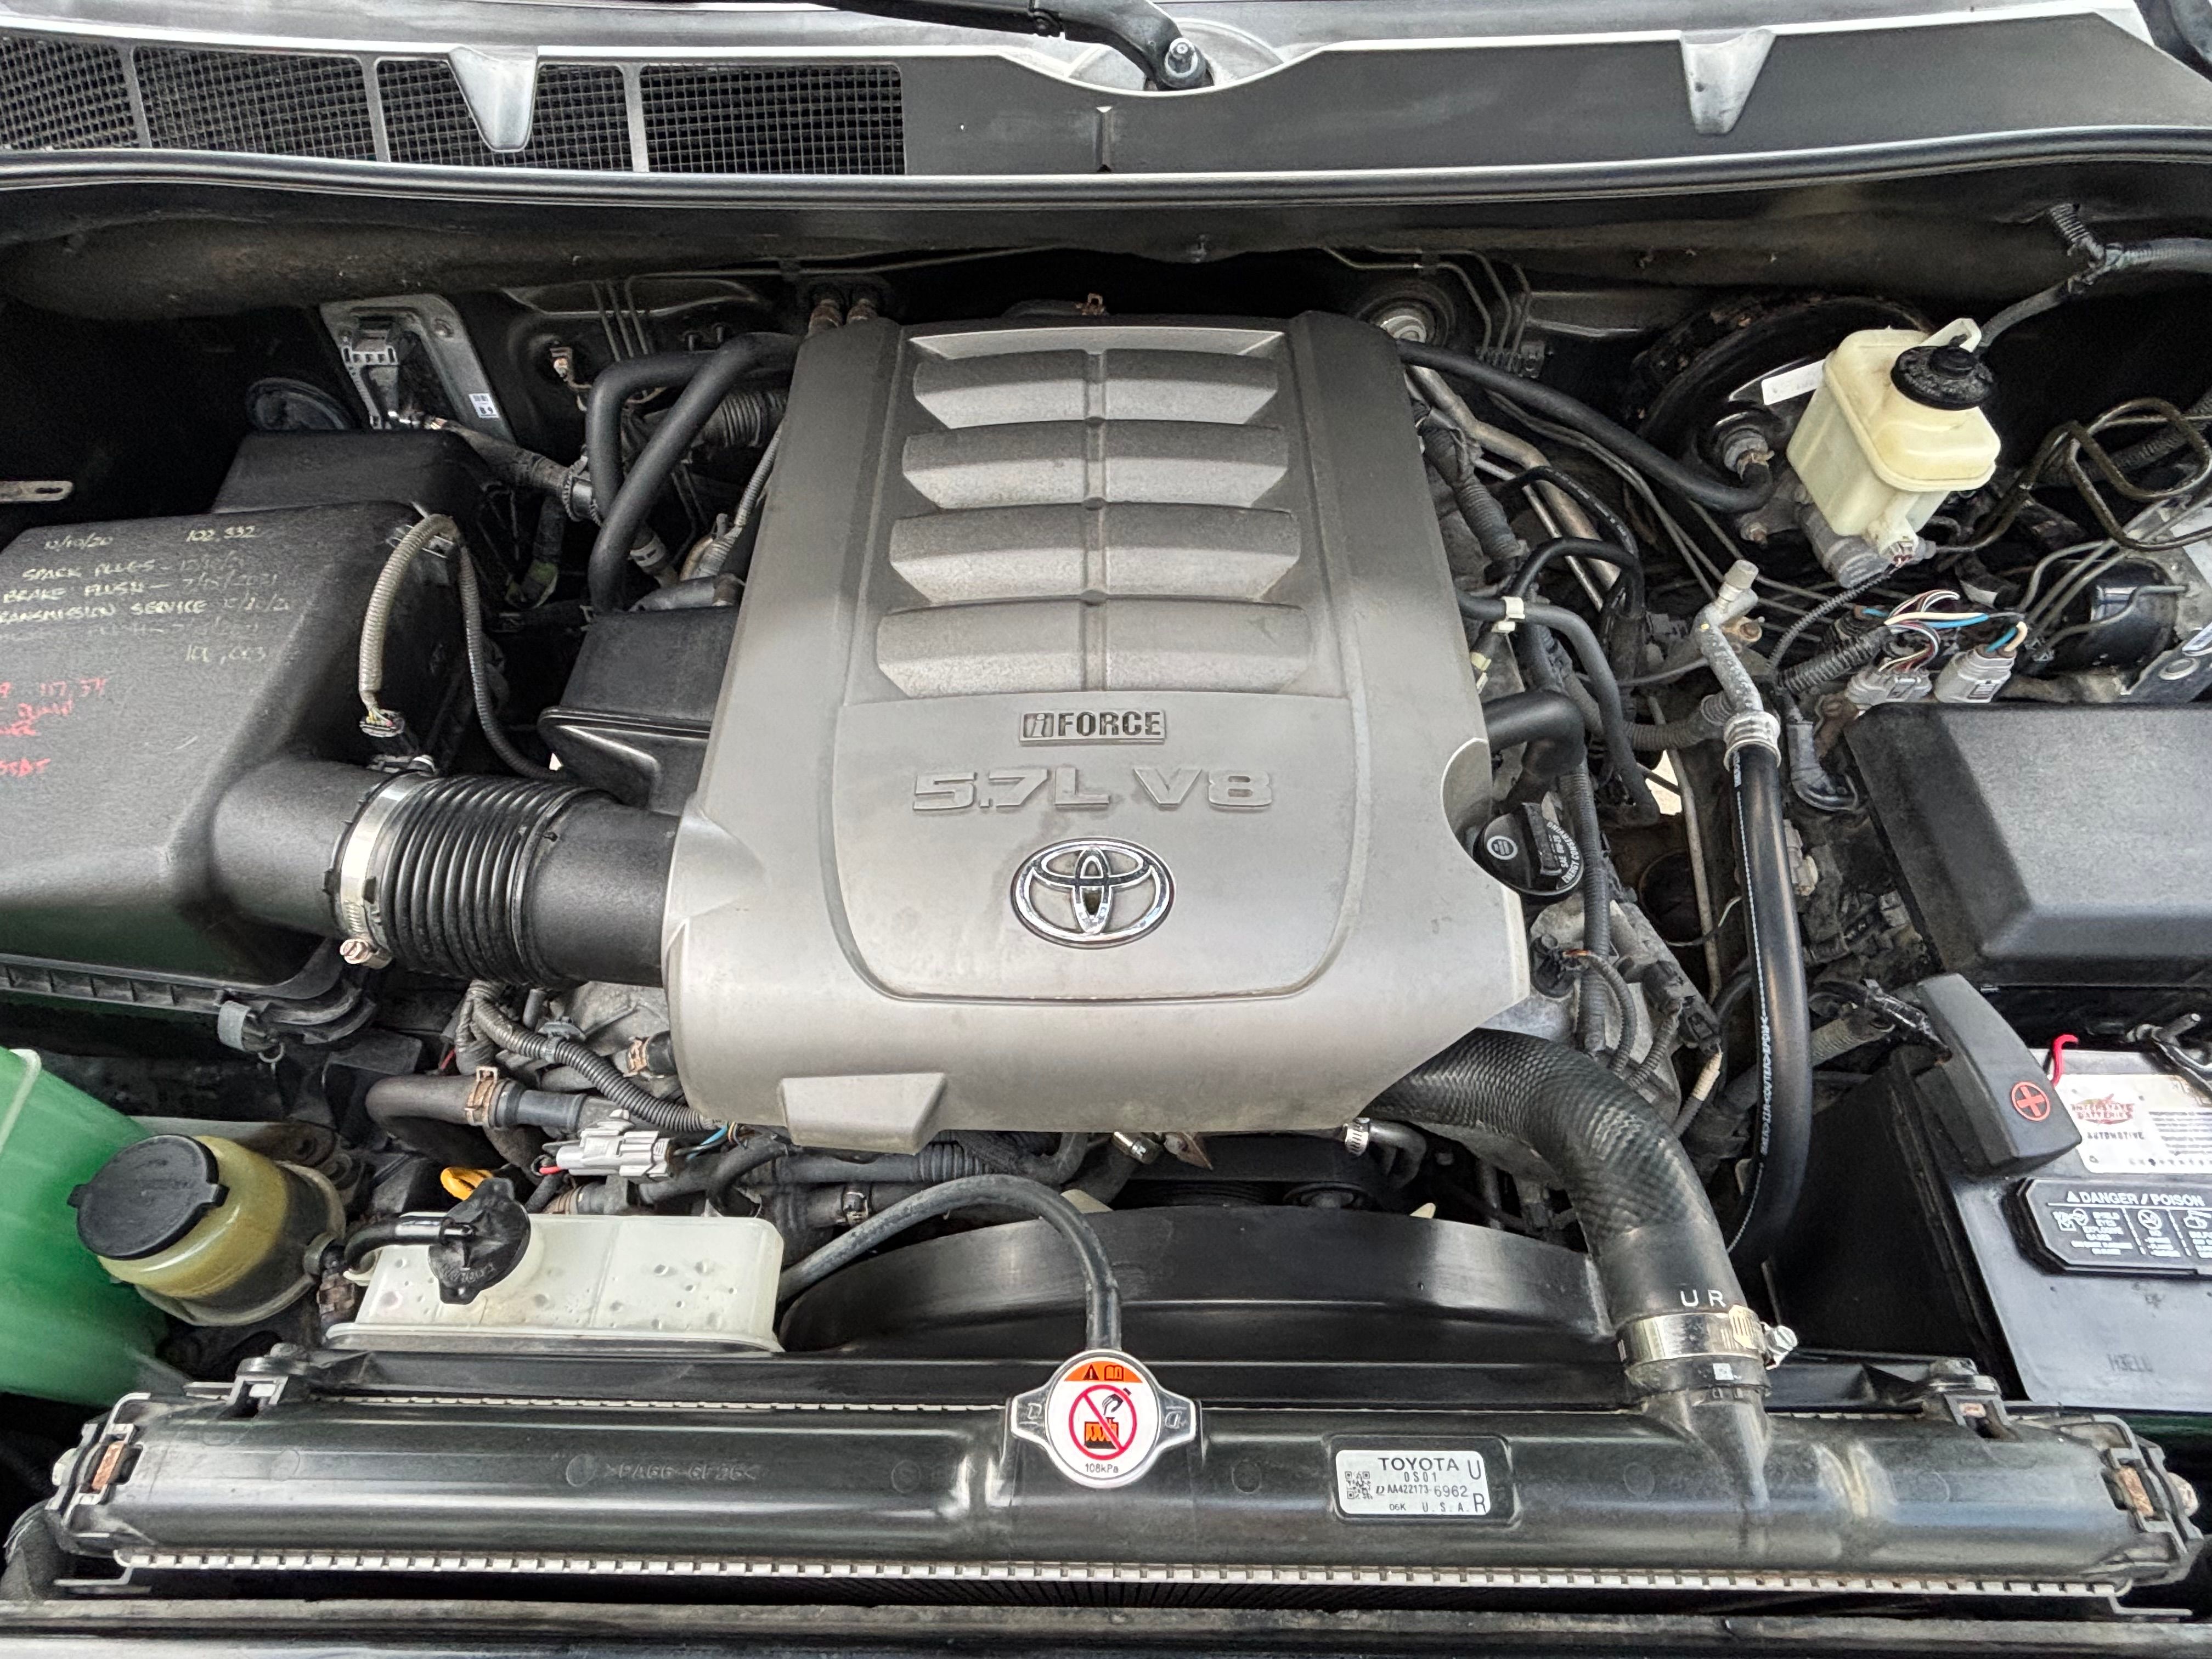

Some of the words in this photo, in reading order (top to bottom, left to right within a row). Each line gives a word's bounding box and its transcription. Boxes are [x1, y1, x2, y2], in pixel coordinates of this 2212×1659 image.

[912, 768, 1110, 811] 5.7L
[1133, 768, 1273, 810] V8
[1547, 822, 1580, 860] CONSERVING
[1561, 860, 1580, 884] ENERGY
[2086, 1131, 2145, 1140] AUTOMOTIVE
[2079, 1192, 2139, 1204] DANGER
[2150, 1193, 2206, 1207] POISON
[1680, 1289, 1699, 1307] U
[1707, 1289, 1726, 1307] R
[1085, 1463, 1119, 1474] 108kPa
[1377, 1457, 1460, 1471] TOYOTA
[1467, 1459, 1481, 1480] U
[1472, 1492, 1487, 1513] R
